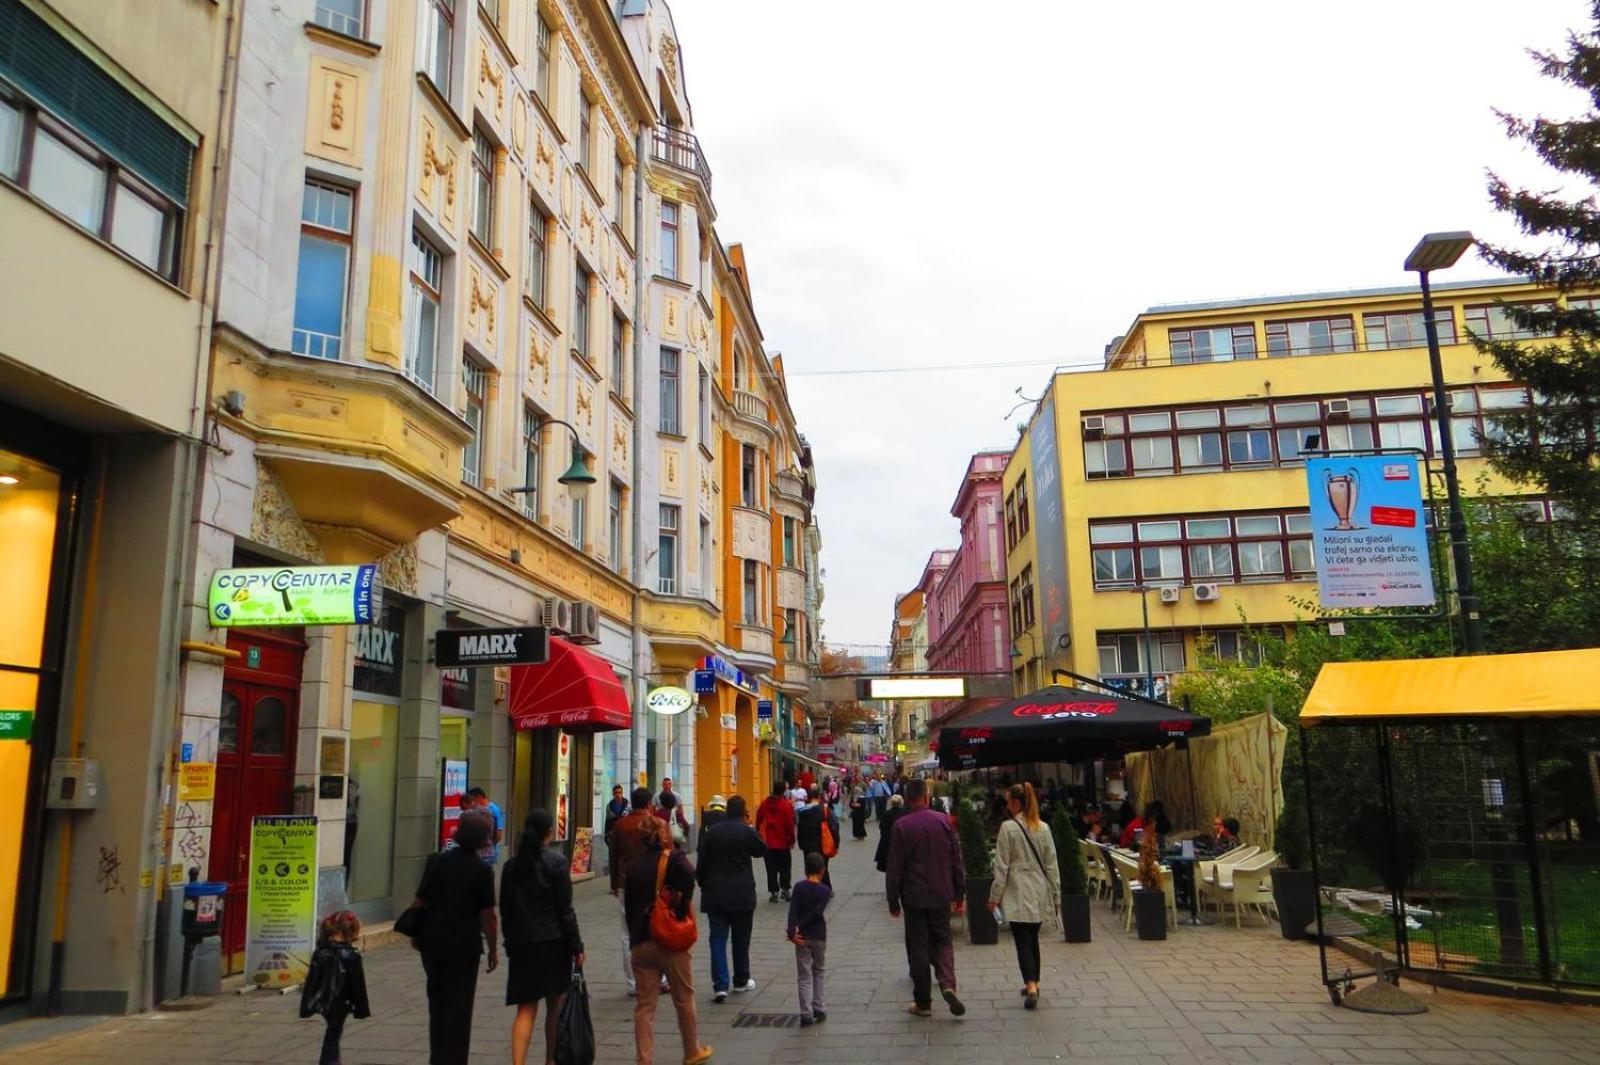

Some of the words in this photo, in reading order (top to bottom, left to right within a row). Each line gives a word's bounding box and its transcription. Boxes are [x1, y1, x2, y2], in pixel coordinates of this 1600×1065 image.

[1323, 535, 1351, 544] Milioni
[1325, 546, 1347, 555] trofej
[1325, 556, 1335, 564] Vi
[1356, 557, 1367, 565] ga
[1368, 554, 1394, 564] vidjeti
[355, 624, 395, 665] ARX
[459, 634, 517, 656] MARX
[561, 709, 589, 722] Coca-Cola
[1041, 711, 1097, 719] zero
